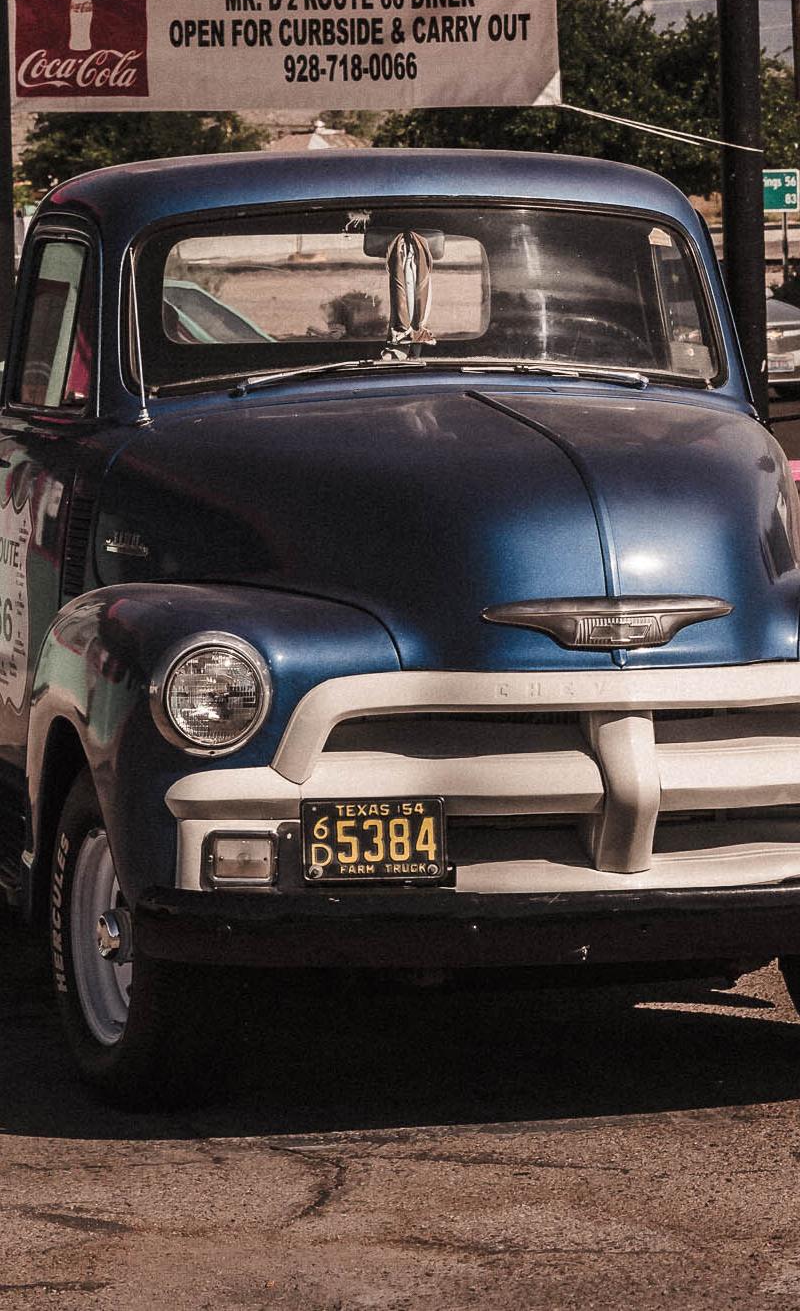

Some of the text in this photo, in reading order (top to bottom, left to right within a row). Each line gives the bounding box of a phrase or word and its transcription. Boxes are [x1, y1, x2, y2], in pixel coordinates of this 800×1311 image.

[169, 13, 531, 47] OPEN FOR CURBSIDE & CARRY OUT
[18, 49, 143, 87] Coca-Cola
[284, 52, 418, 83] 928-718-0066
[784, 175, 797, 187] 56
[336, 804, 390, 816] TEXAS
[311, 843, 333, 867] D
[313, 816, 437, 864] 6 5384
[340, 863, 427, 874] FARM TRUCK
[52, 832, 70, 993] HERCULES
